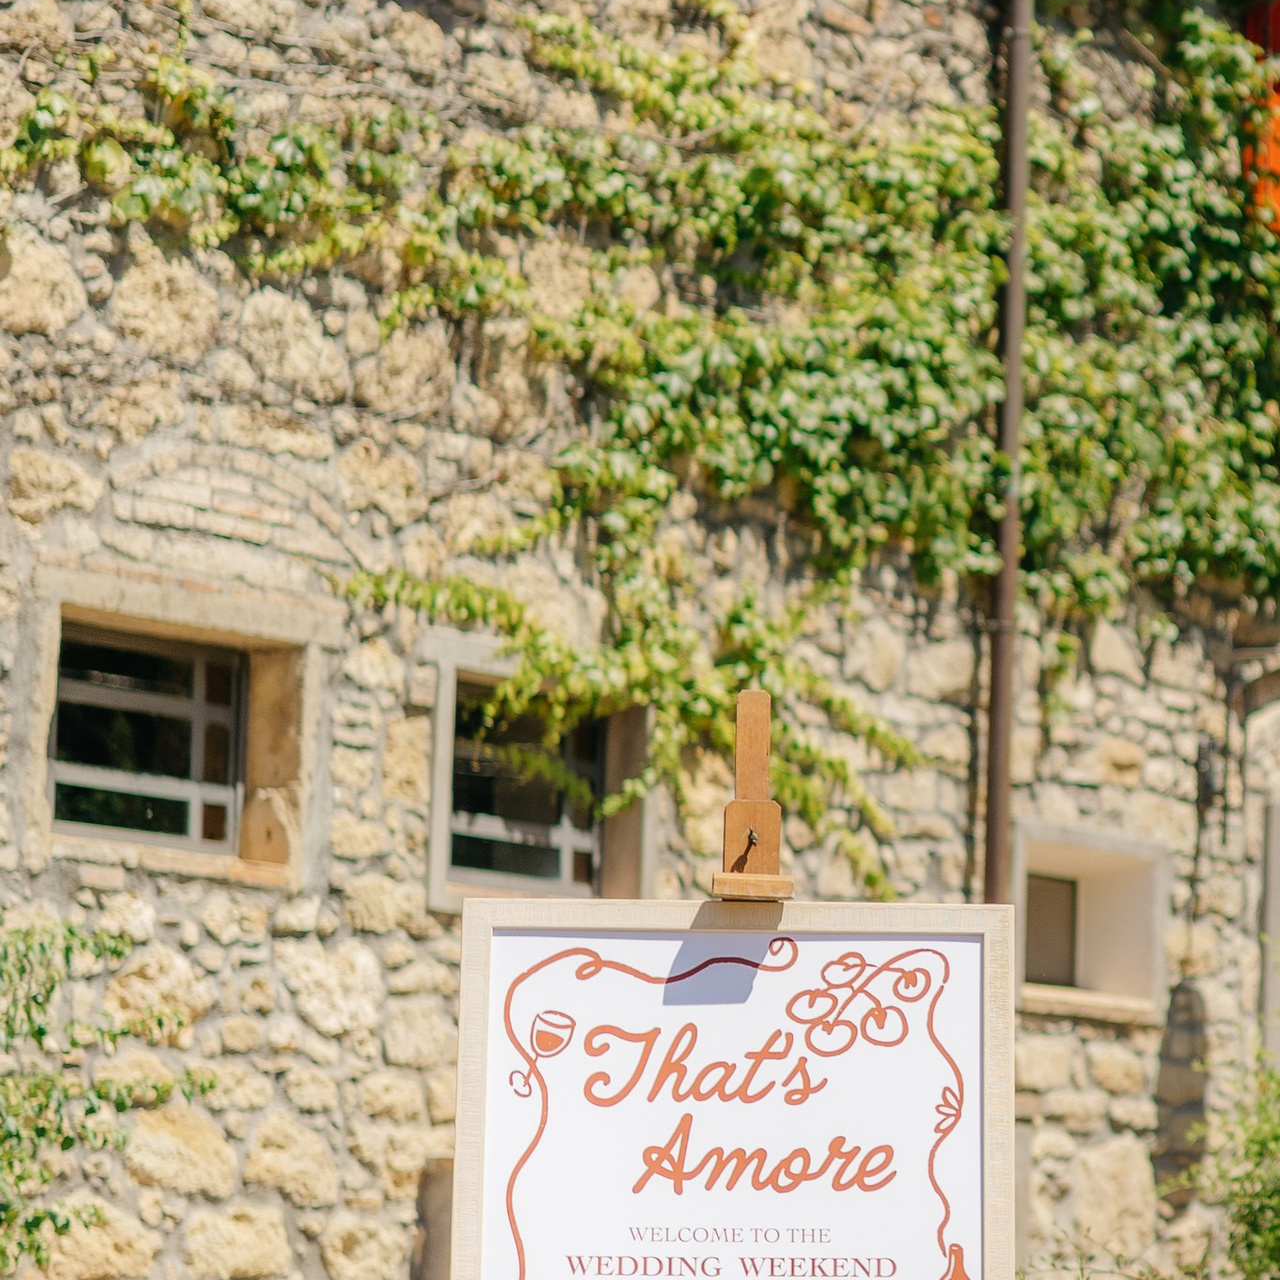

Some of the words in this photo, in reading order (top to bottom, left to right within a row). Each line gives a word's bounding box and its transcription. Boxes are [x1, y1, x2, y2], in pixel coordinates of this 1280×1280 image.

[583, 1022, 828, 1107] That's
[632, 1113, 897, 1195] Amore
[629, 1226, 744, 1243] WELCOME
[750, 1228, 781, 1244] TO
[787, 1228, 831, 1244] THE
[565, 1255, 723, 1278] WEDDING
[738, 1256, 898, 1278] WEEKEND
